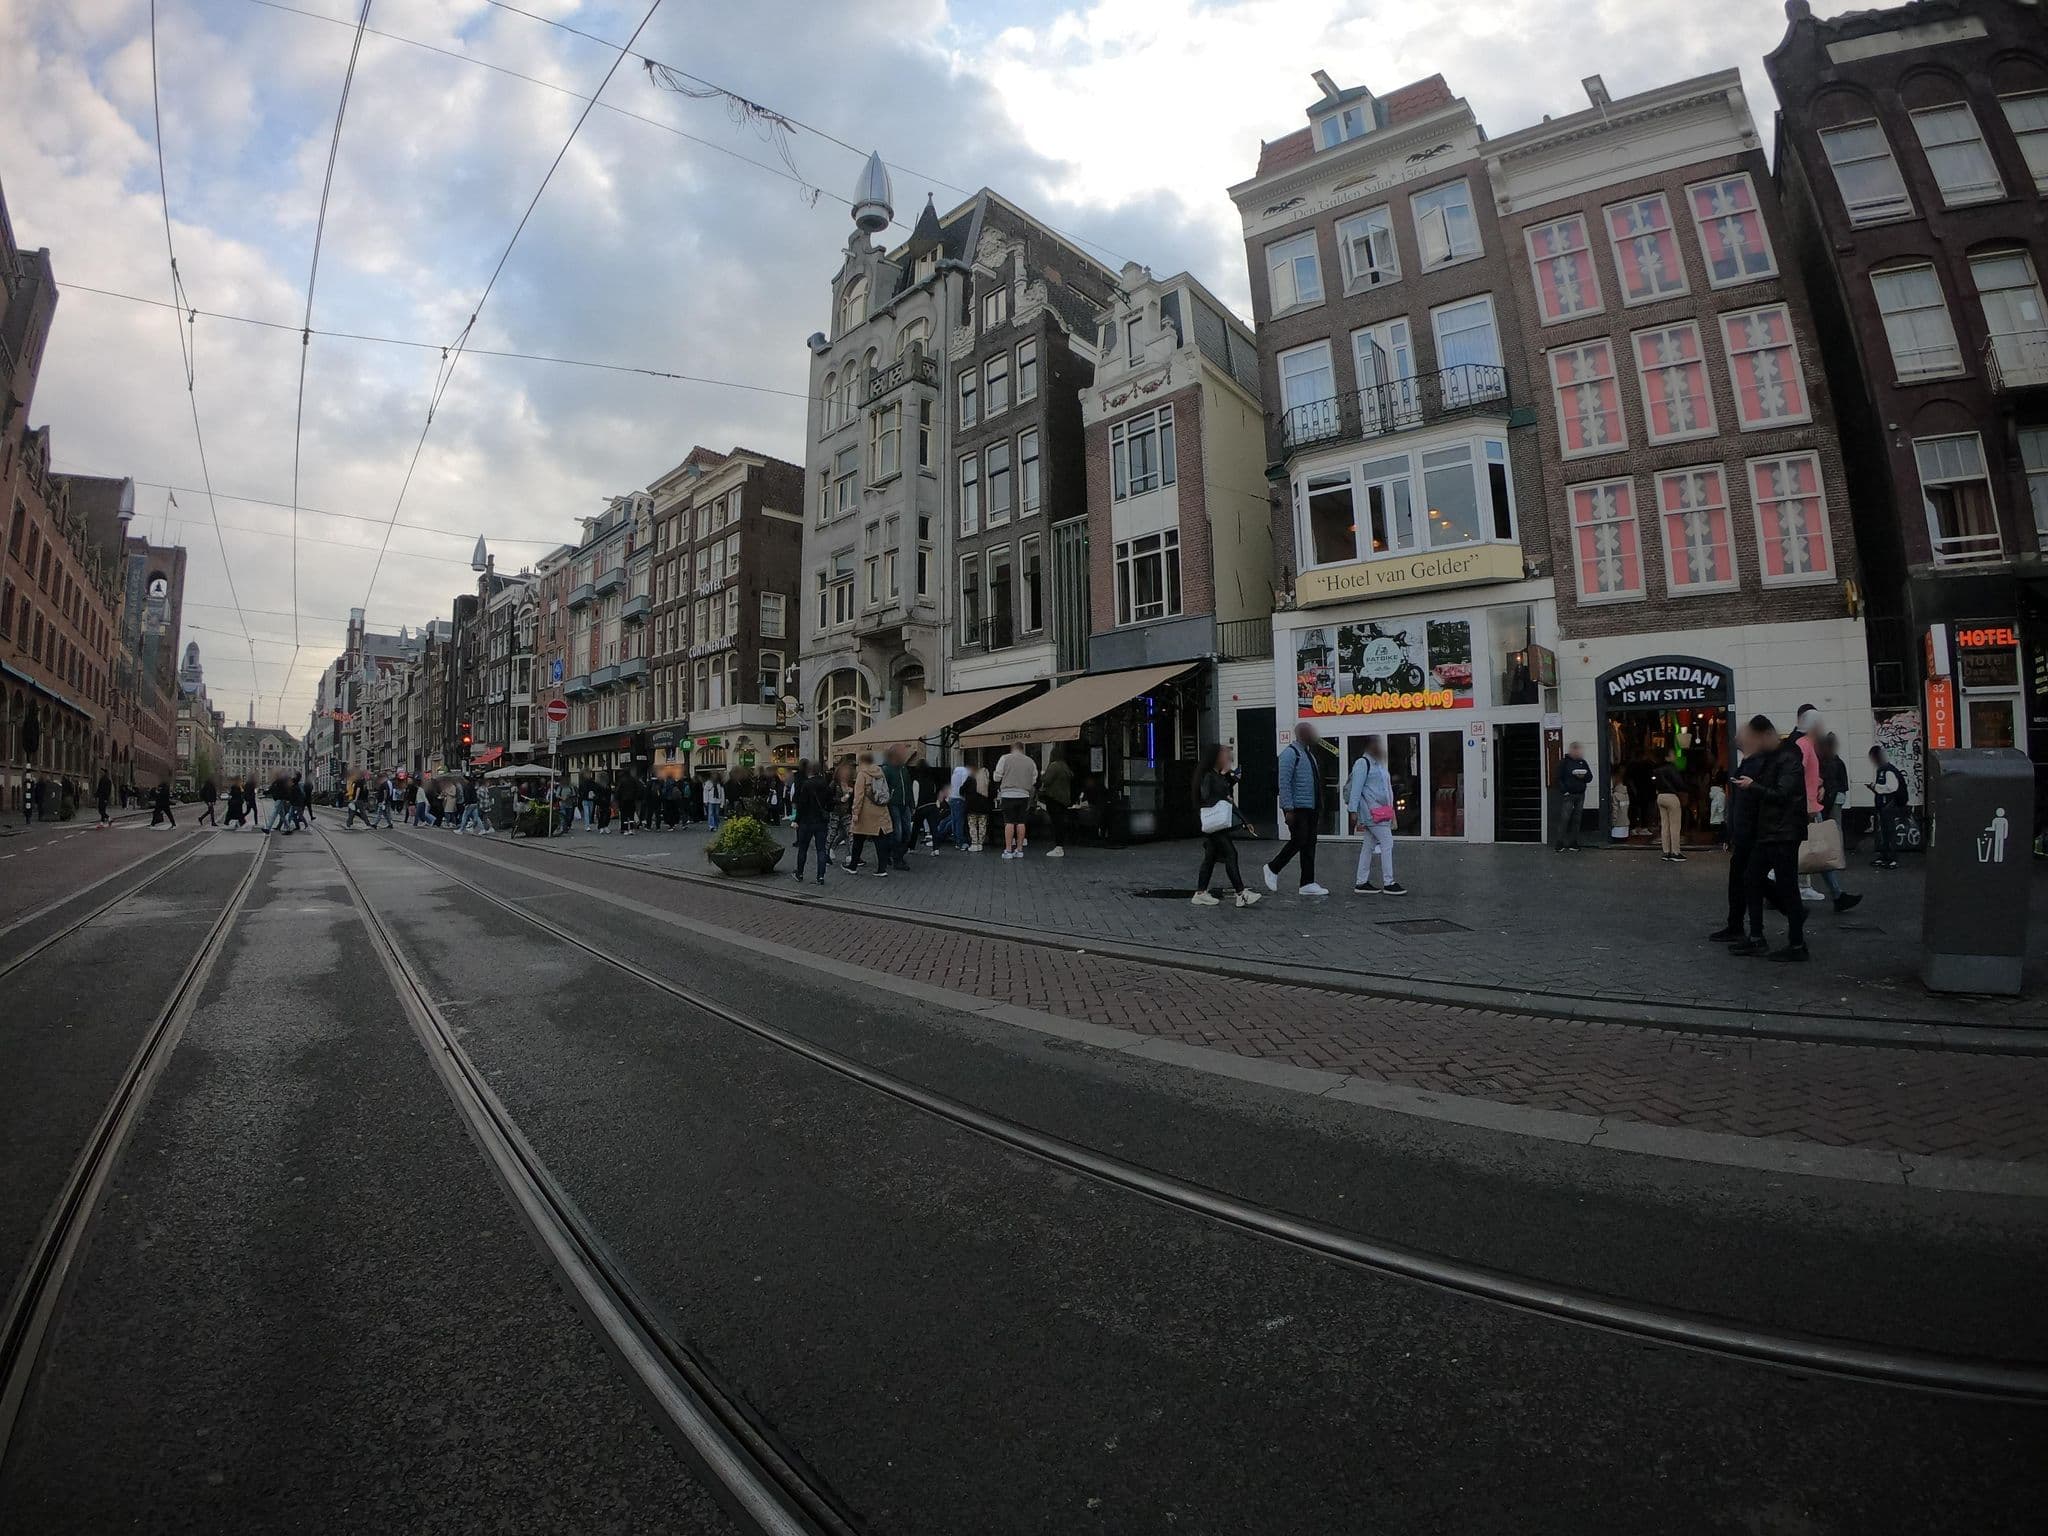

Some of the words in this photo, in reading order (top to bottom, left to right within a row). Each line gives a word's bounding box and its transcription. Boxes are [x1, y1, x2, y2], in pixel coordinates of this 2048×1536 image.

[1376, 568, 1405, 583] van
[700, 580, 723, 596] HOTEL
[1959, 628, 2018, 646] HOTEL
[689, 638, 732, 658] CONTINENTAL
[1608, 666, 1720, 696] AMSTERDAM
[1932, 683, 1945, 693] 32
[1312, 689, 1454, 715] CitySightseeing
[1622, 691, 1636, 703] IS
[1639, 689, 1661, 702] MY
[1664, 687, 1705, 700] STYLE
[1935, 697, 1947, 747] HOTE
[1548, 731, 1559, 741] 34
